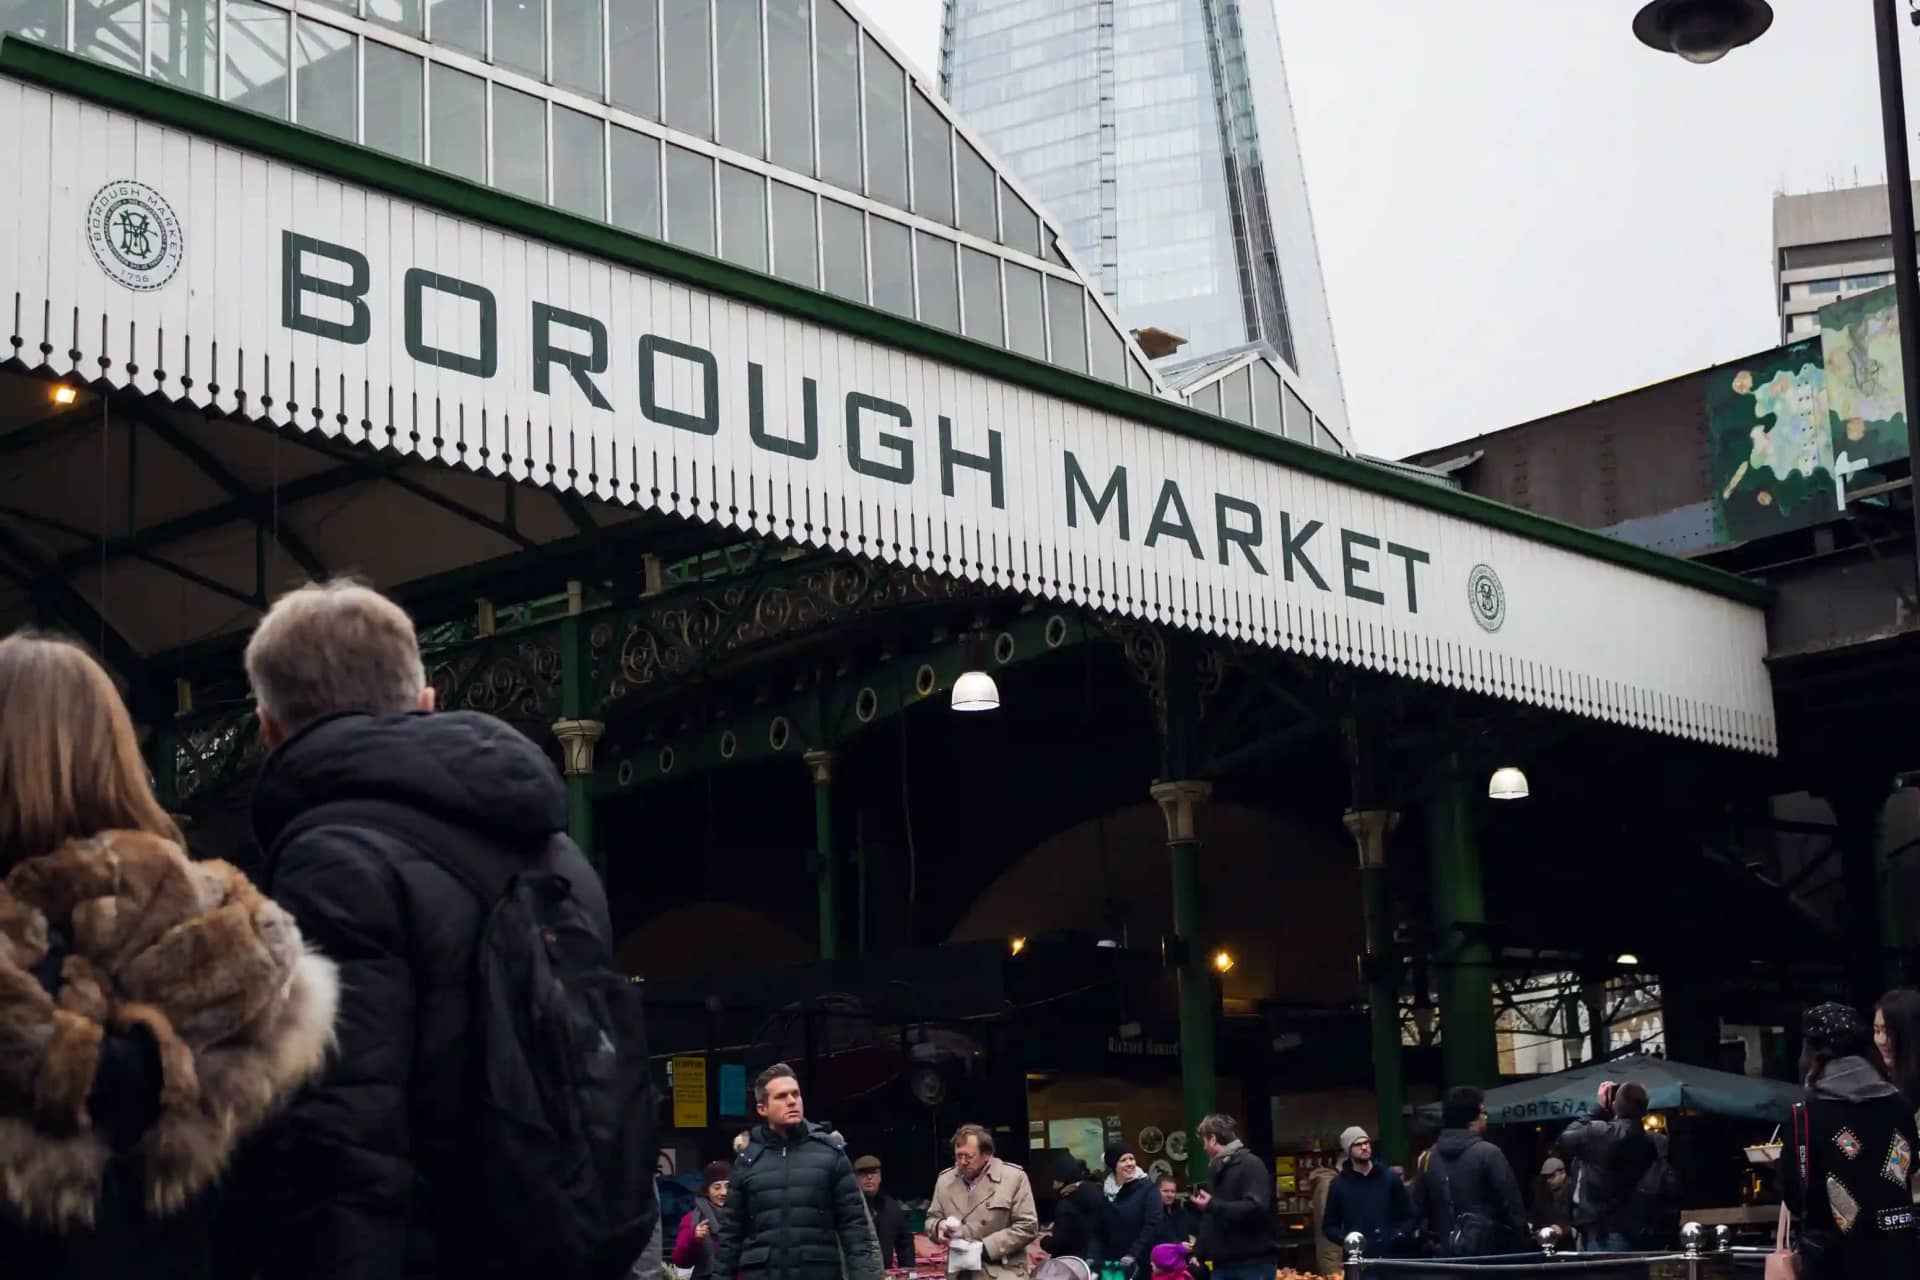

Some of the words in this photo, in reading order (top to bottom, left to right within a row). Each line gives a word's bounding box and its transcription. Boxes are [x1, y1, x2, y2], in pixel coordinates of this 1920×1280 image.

[93, 187, 140, 242] BOROUGH
[147, 195, 178, 261] MARKET
[120, 269, 150, 283] 1756
[281, 229, 1006, 510] BOROUGH
[1063, 449, 1431, 614] MARKET
[1501, 1098, 1588, 1119] PORTEÑA
